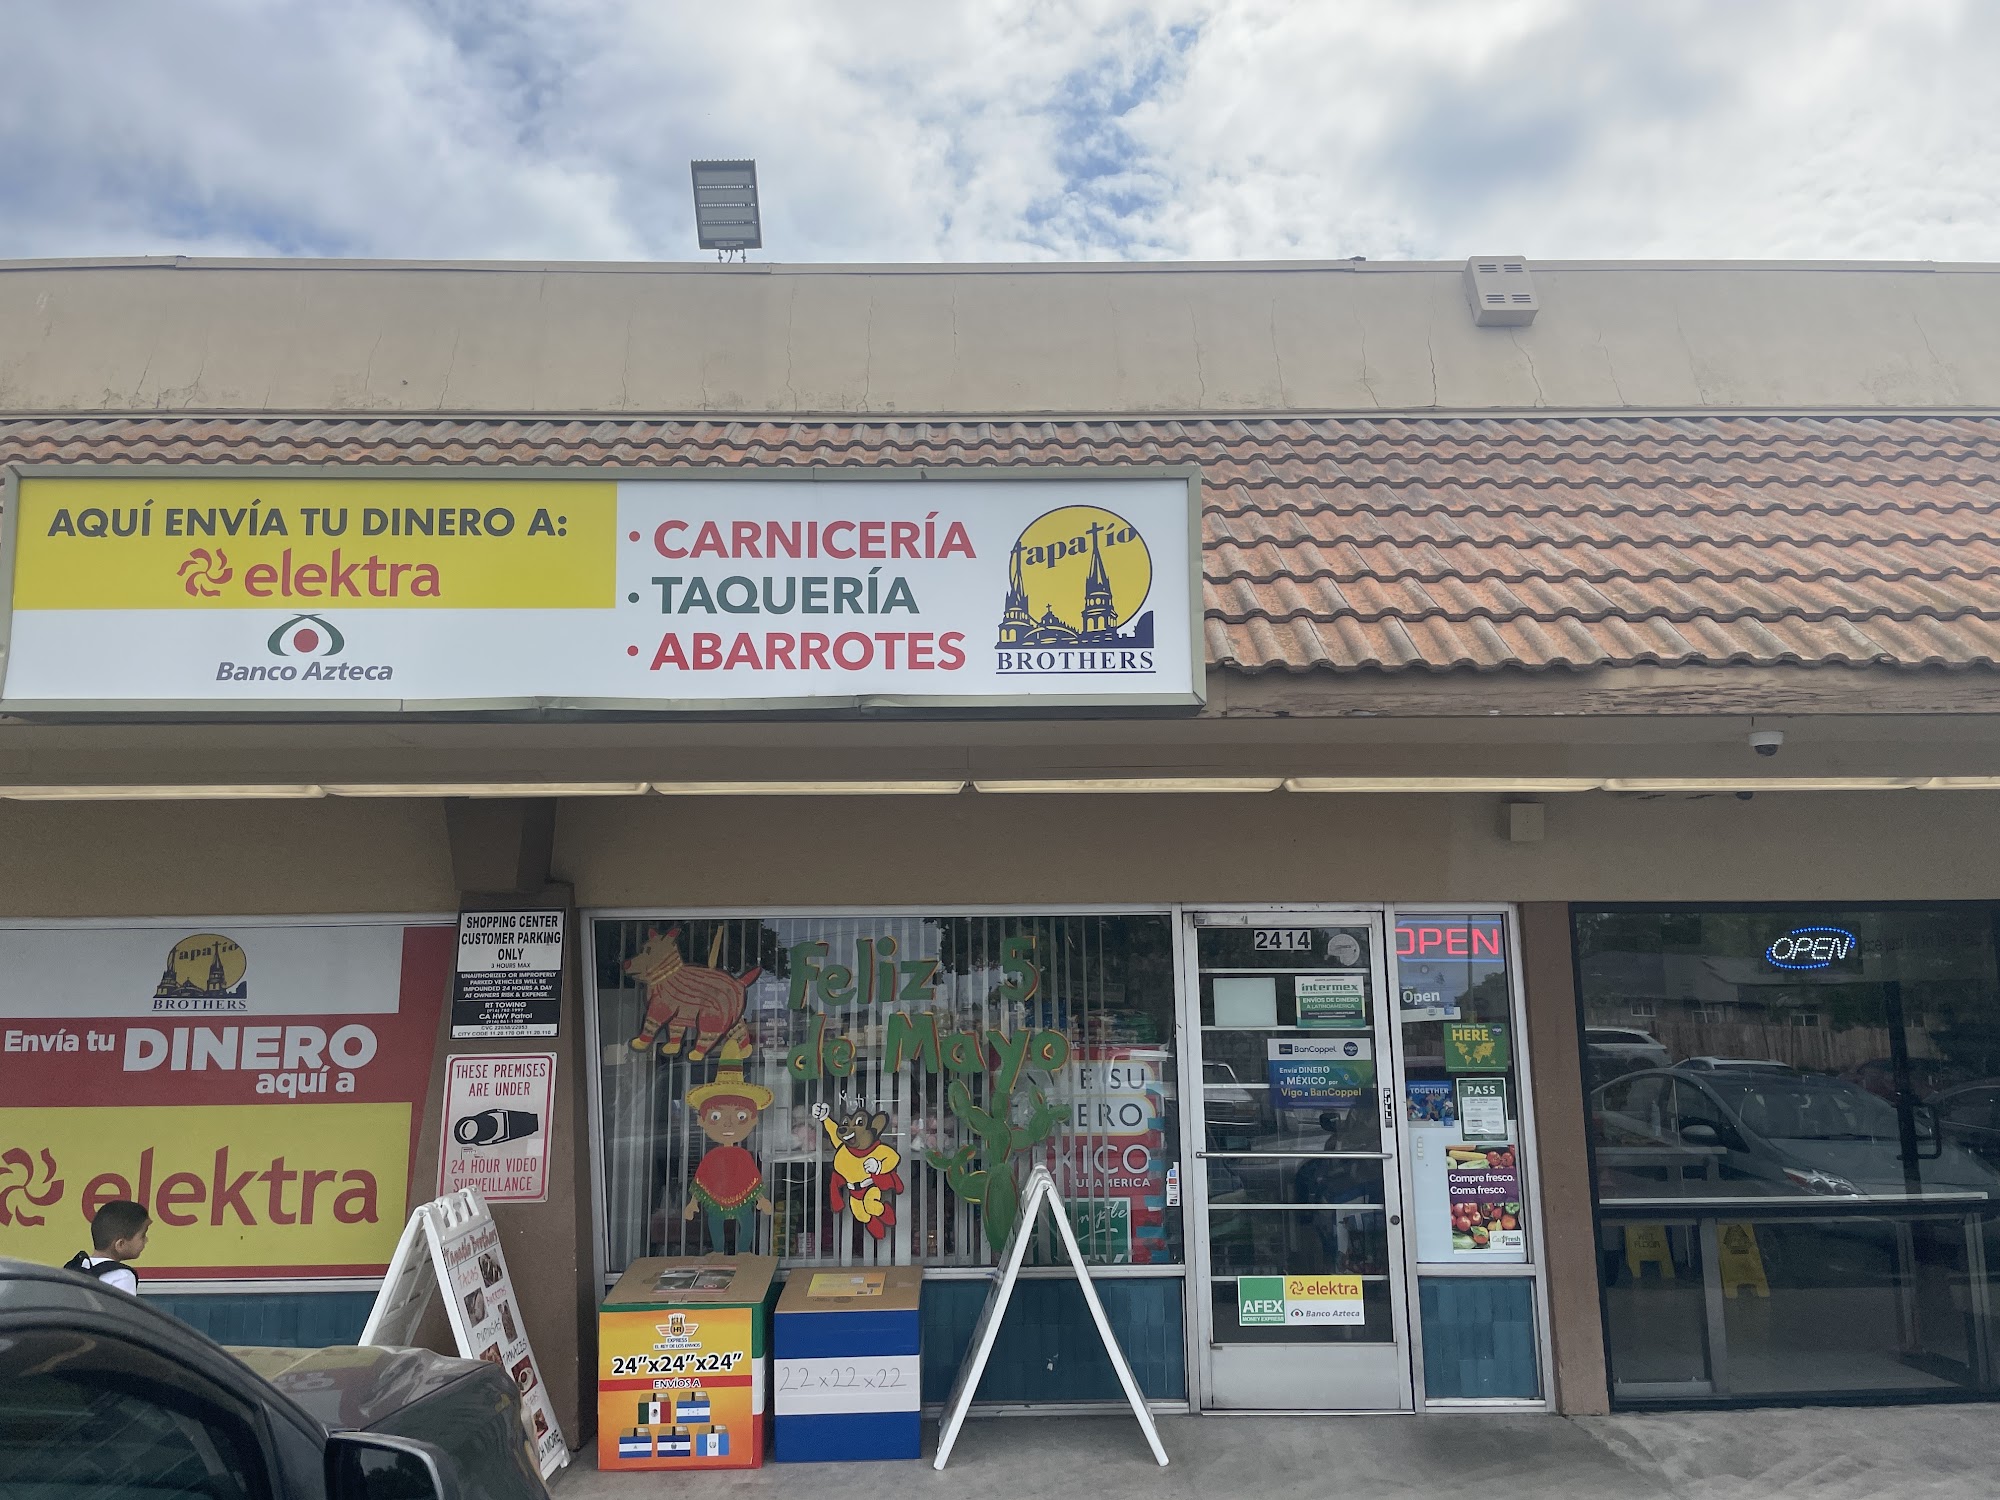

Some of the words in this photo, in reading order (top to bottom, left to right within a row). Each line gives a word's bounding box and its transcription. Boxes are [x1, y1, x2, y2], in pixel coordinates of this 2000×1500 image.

[48, 498, 154, 539] AQUÍ
[165, 499, 289, 537] ENVÍA
[300, 508, 348, 536] TU
[362, 507, 515, 537] DINERO
[527, 508, 568, 537] A:
[653, 511, 977, 560] CARNICERÍA
[244, 547, 441, 598] elektra
[651, 566, 920, 615] TAQUERÍA
[650, 630, 966, 671] ABARROTES
[996, 651, 1155, 672] BROTHERS
[216, 661, 297, 682] Banco
[302, 660, 394, 682] Azteca
[466, 916, 517, 928] SHOPPING
[519, 916, 558, 928] CENTER
[462, 932, 515, 945] CUSTOMER
[518, 932, 561, 944] PARKING
[1256, 932, 1310, 949] 2414
[1395, 927, 1499, 955] OPEN
[498, 948, 524, 961] ONLY
[1771, 936, 1851, 961] OPEN
[787, 936, 941, 1011] Feliz
[1000, 935, 1038, 1003] 5
[1302, 983, 1358, 992] intermex
[153, 998, 248, 1011] BROTHERS
[1402, 990, 1440, 1005] Open
[4, 1028, 79, 1052] Envía
[86, 1030, 115, 1052] tu
[123, 1024, 378, 1071] DINERO
[786, 1012, 856, 1081] de
[884, 1011, 1071, 1094] Mayo
[1294, 1046, 1337, 1054] BanCoppel
[456, 1065, 488, 1079] THESE
[494, 1063, 546, 1078] PREMISES
[1110, 1068, 1145, 1090] SU
[256, 1065, 331, 1099] aquí
[336, 1072, 355, 1093] a
[1286, 1074, 1326, 1085] MÉXICO
[468, 1082, 490, 1096] ARE
[496, 1082, 530, 1096] UNDER
[1281, 1088, 1302, 1098] Vigo
[1310, 1088, 1362, 1098] BanCoppel
[1467, 1086, 1496, 1094] PASS
[1384, 1090, 1392, 1119] PULL
[452, 1160, 465, 1174] 24
[471, 1158, 500, 1174] HOUR
[506, 1158, 537, 1172] VIDEO
[81, 1145, 380, 1228] elektra
[1450, 1174, 1484, 1184] Compre
[1486, 1173, 1515, 1182] fresco.
[1450, 1186, 1476, 1195] Coma
[1478, 1185, 1507, 1194] fresco.
[1306, 1281, 1358, 1295] elektra
[1242, 1300, 1284, 1314] AFEX
[1306, 1310, 1331, 1318] Banco
[1332, 1310, 1360, 1318] Azteca
[692, 1378, 700, 1388] A
